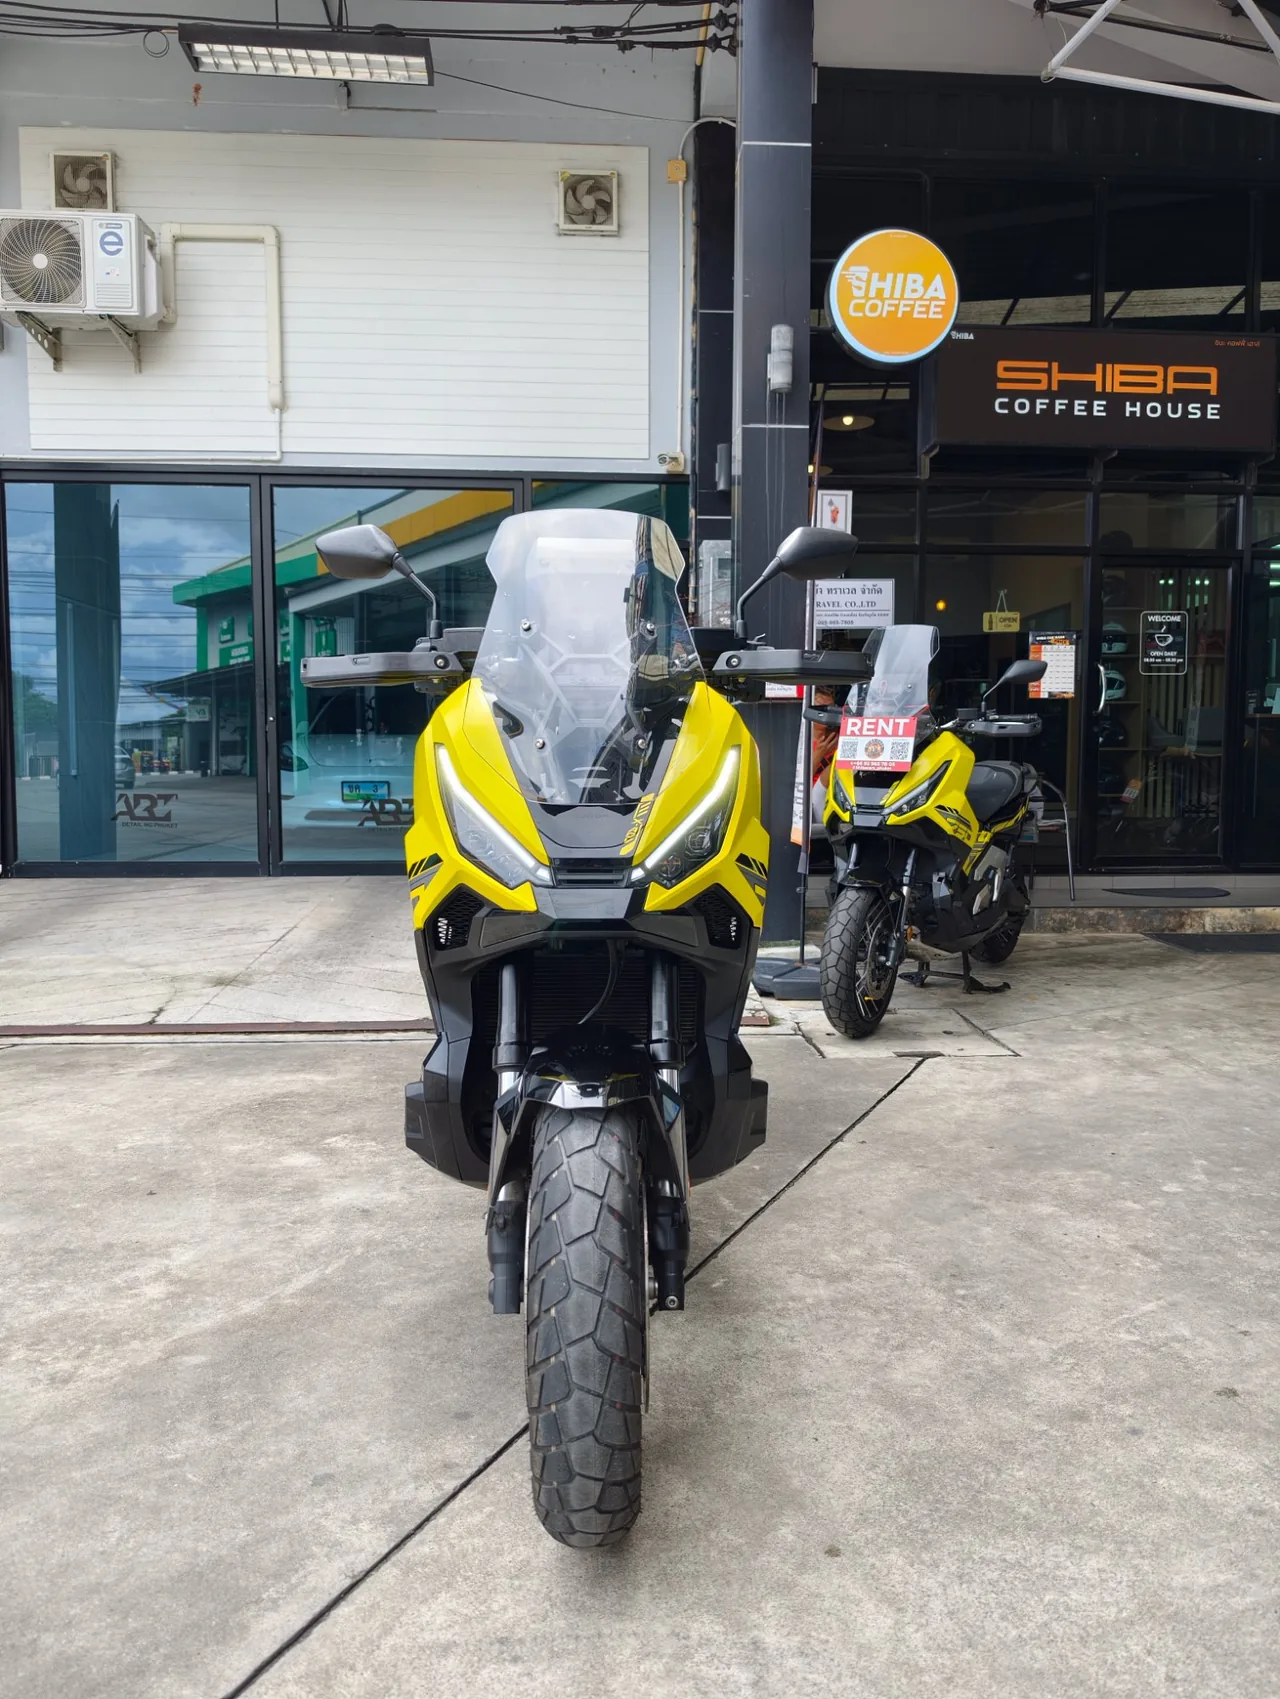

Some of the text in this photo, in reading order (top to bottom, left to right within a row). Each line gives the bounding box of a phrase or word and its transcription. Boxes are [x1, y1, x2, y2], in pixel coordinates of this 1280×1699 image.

[848, 266, 947, 300] SHIBA
[848, 298, 946, 319] COFFEE
[996, 360, 1218, 396] SHIBA
[994, 398, 1221, 420] COFFEE HOUSE
[846, 718, 910, 736] RENT
